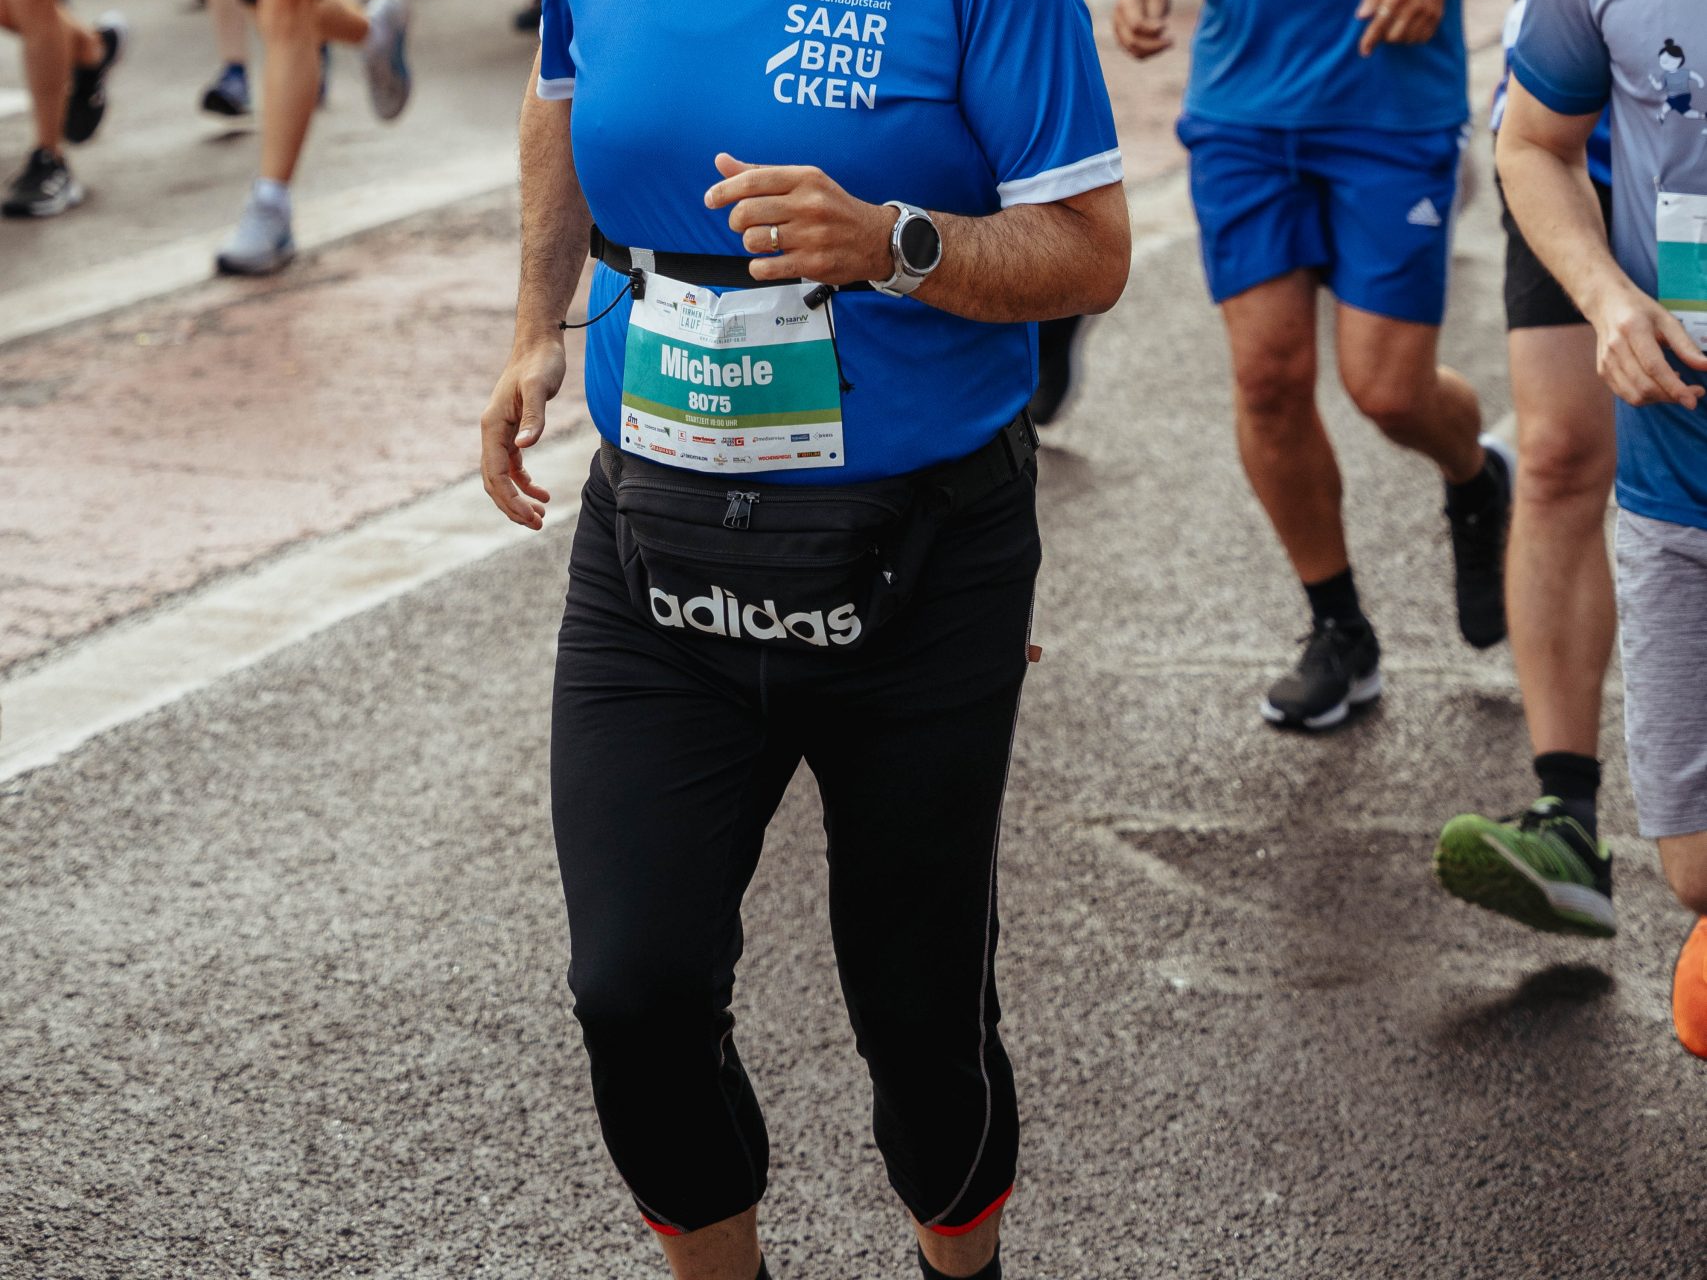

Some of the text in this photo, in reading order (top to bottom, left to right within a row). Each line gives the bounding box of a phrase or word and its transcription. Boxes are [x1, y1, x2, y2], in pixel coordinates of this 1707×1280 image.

[784, 4, 888, 45] SAAR
[800, 40, 883, 79] BRÜ
[773, 72, 877, 110] CKEN
[680, 317, 701, 330] LAUF
[682, 307, 703, 319] FIRMEN
[660, 344, 773, 387] Michele
[688, 391, 732, 414] 8075
[725, 419, 738, 427] UHR
[649, 584, 862, 647] adidas
